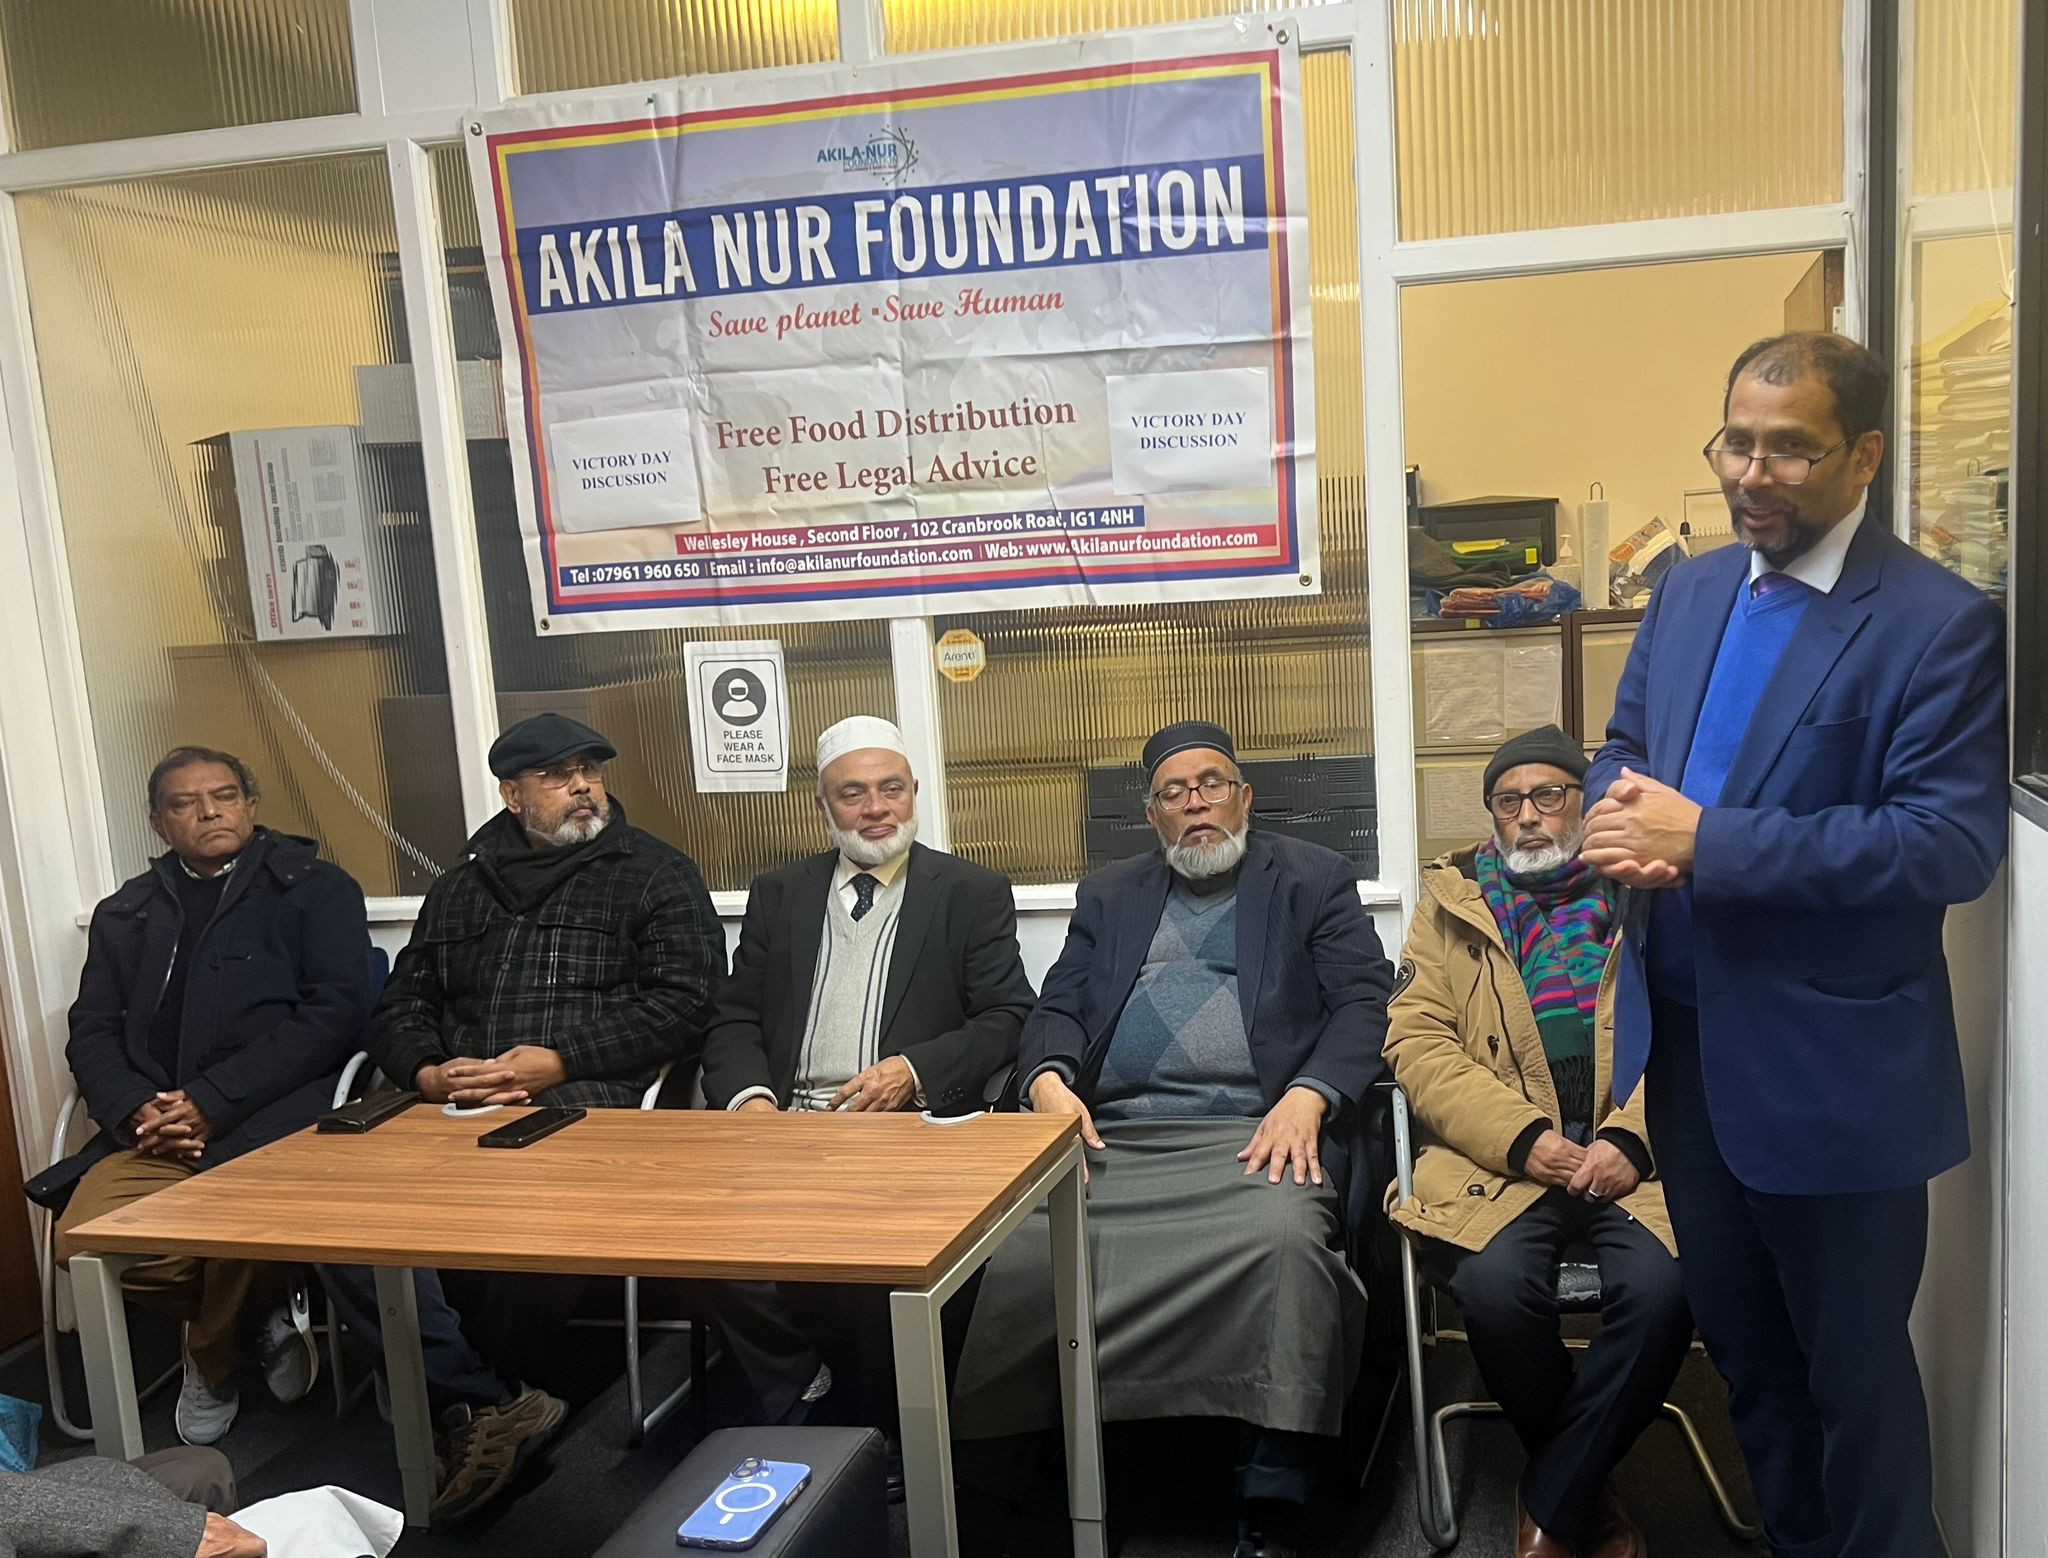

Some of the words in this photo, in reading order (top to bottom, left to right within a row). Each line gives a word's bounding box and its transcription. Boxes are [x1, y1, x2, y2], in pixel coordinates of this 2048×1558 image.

[817, 143, 897, 163] AKILA-NUR
[539, 219, 697, 307] AKILA
[711, 205, 836, 289] NUR
[854, 166, 1245, 277] FOUNDATION
[709, 310, 768, 337] Save
[776, 302, 862, 340] planet
[883, 294, 945, 322] Save
[954, 288, 1064, 316] Human
[716, 421, 782, 449] Free
[788, 410, 867, 444] Food
[875, 397, 1076, 437] Distribution
[1131, 412, 1207, 428] VICTORY
[1213, 411, 1246, 426] DAY
[1140, 433, 1238, 449] DISCUSSION
[572, 453, 637, 470] VICTORY
[642, 450, 671, 465] DAY
[582, 471, 667, 489] DISCUSSION
[762, 466, 828, 494] Free
[835, 456, 918, 496] Legal
[927, 450, 1037, 483] Advice
[684, 535, 748, 552] Wellesley
[807, 526, 859, 544] Second
[911, 522, 939, 537] 102
[942, 514, 1023, 535] Cranbrook
[1070, 511, 1096, 527] IG1
[1100, 508, 1134, 525] 4NH
[644, 564, 672, 579] 960
[674, 563, 700, 577] 650
[757, 548, 973, 574] info@akilanurfoundation.com
[985, 541, 1023, 559] Web:
[723, 730, 763, 740] PLEASE
[723, 742, 754, 751] WEAR
[757, 742, 765, 751] A
[717, 754, 742, 763] FACE
[745, 753, 775, 763] MASK
